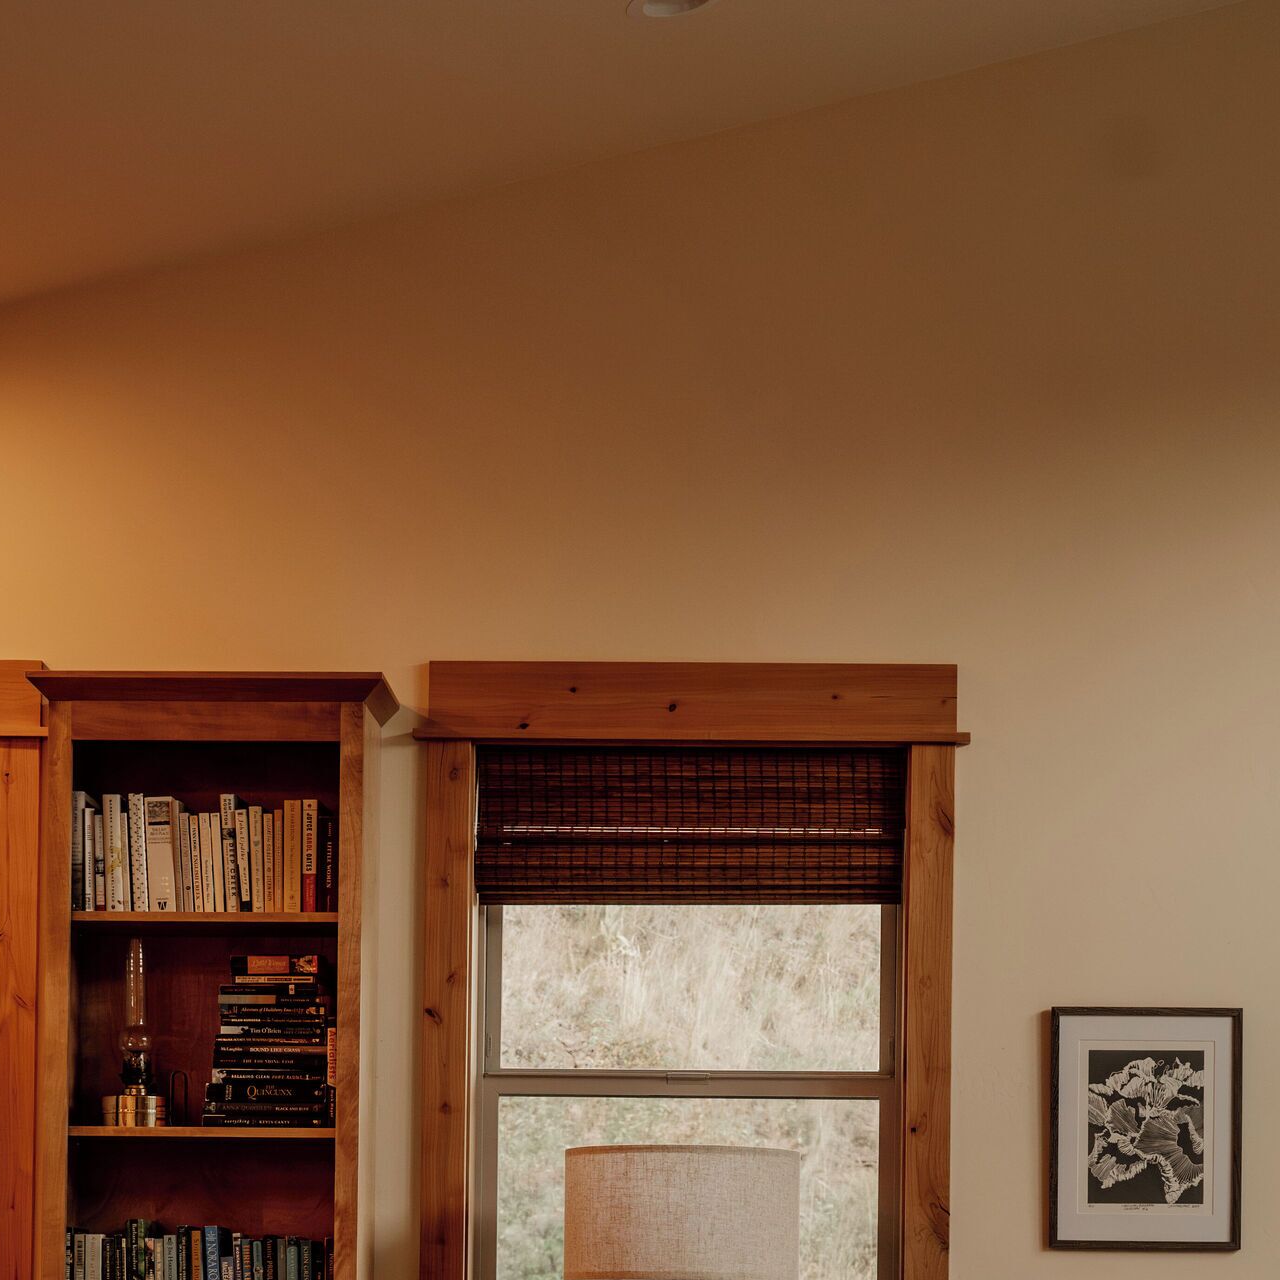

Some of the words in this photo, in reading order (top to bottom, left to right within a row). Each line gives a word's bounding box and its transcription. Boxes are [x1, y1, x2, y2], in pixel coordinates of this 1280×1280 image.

[328, 1029, 336, 1079] Aerialists
[207, 1243, 217, 1267] NORA
[243, 1244, 251, 1269] THREE
[266, 1239, 274, 1260] Annie
